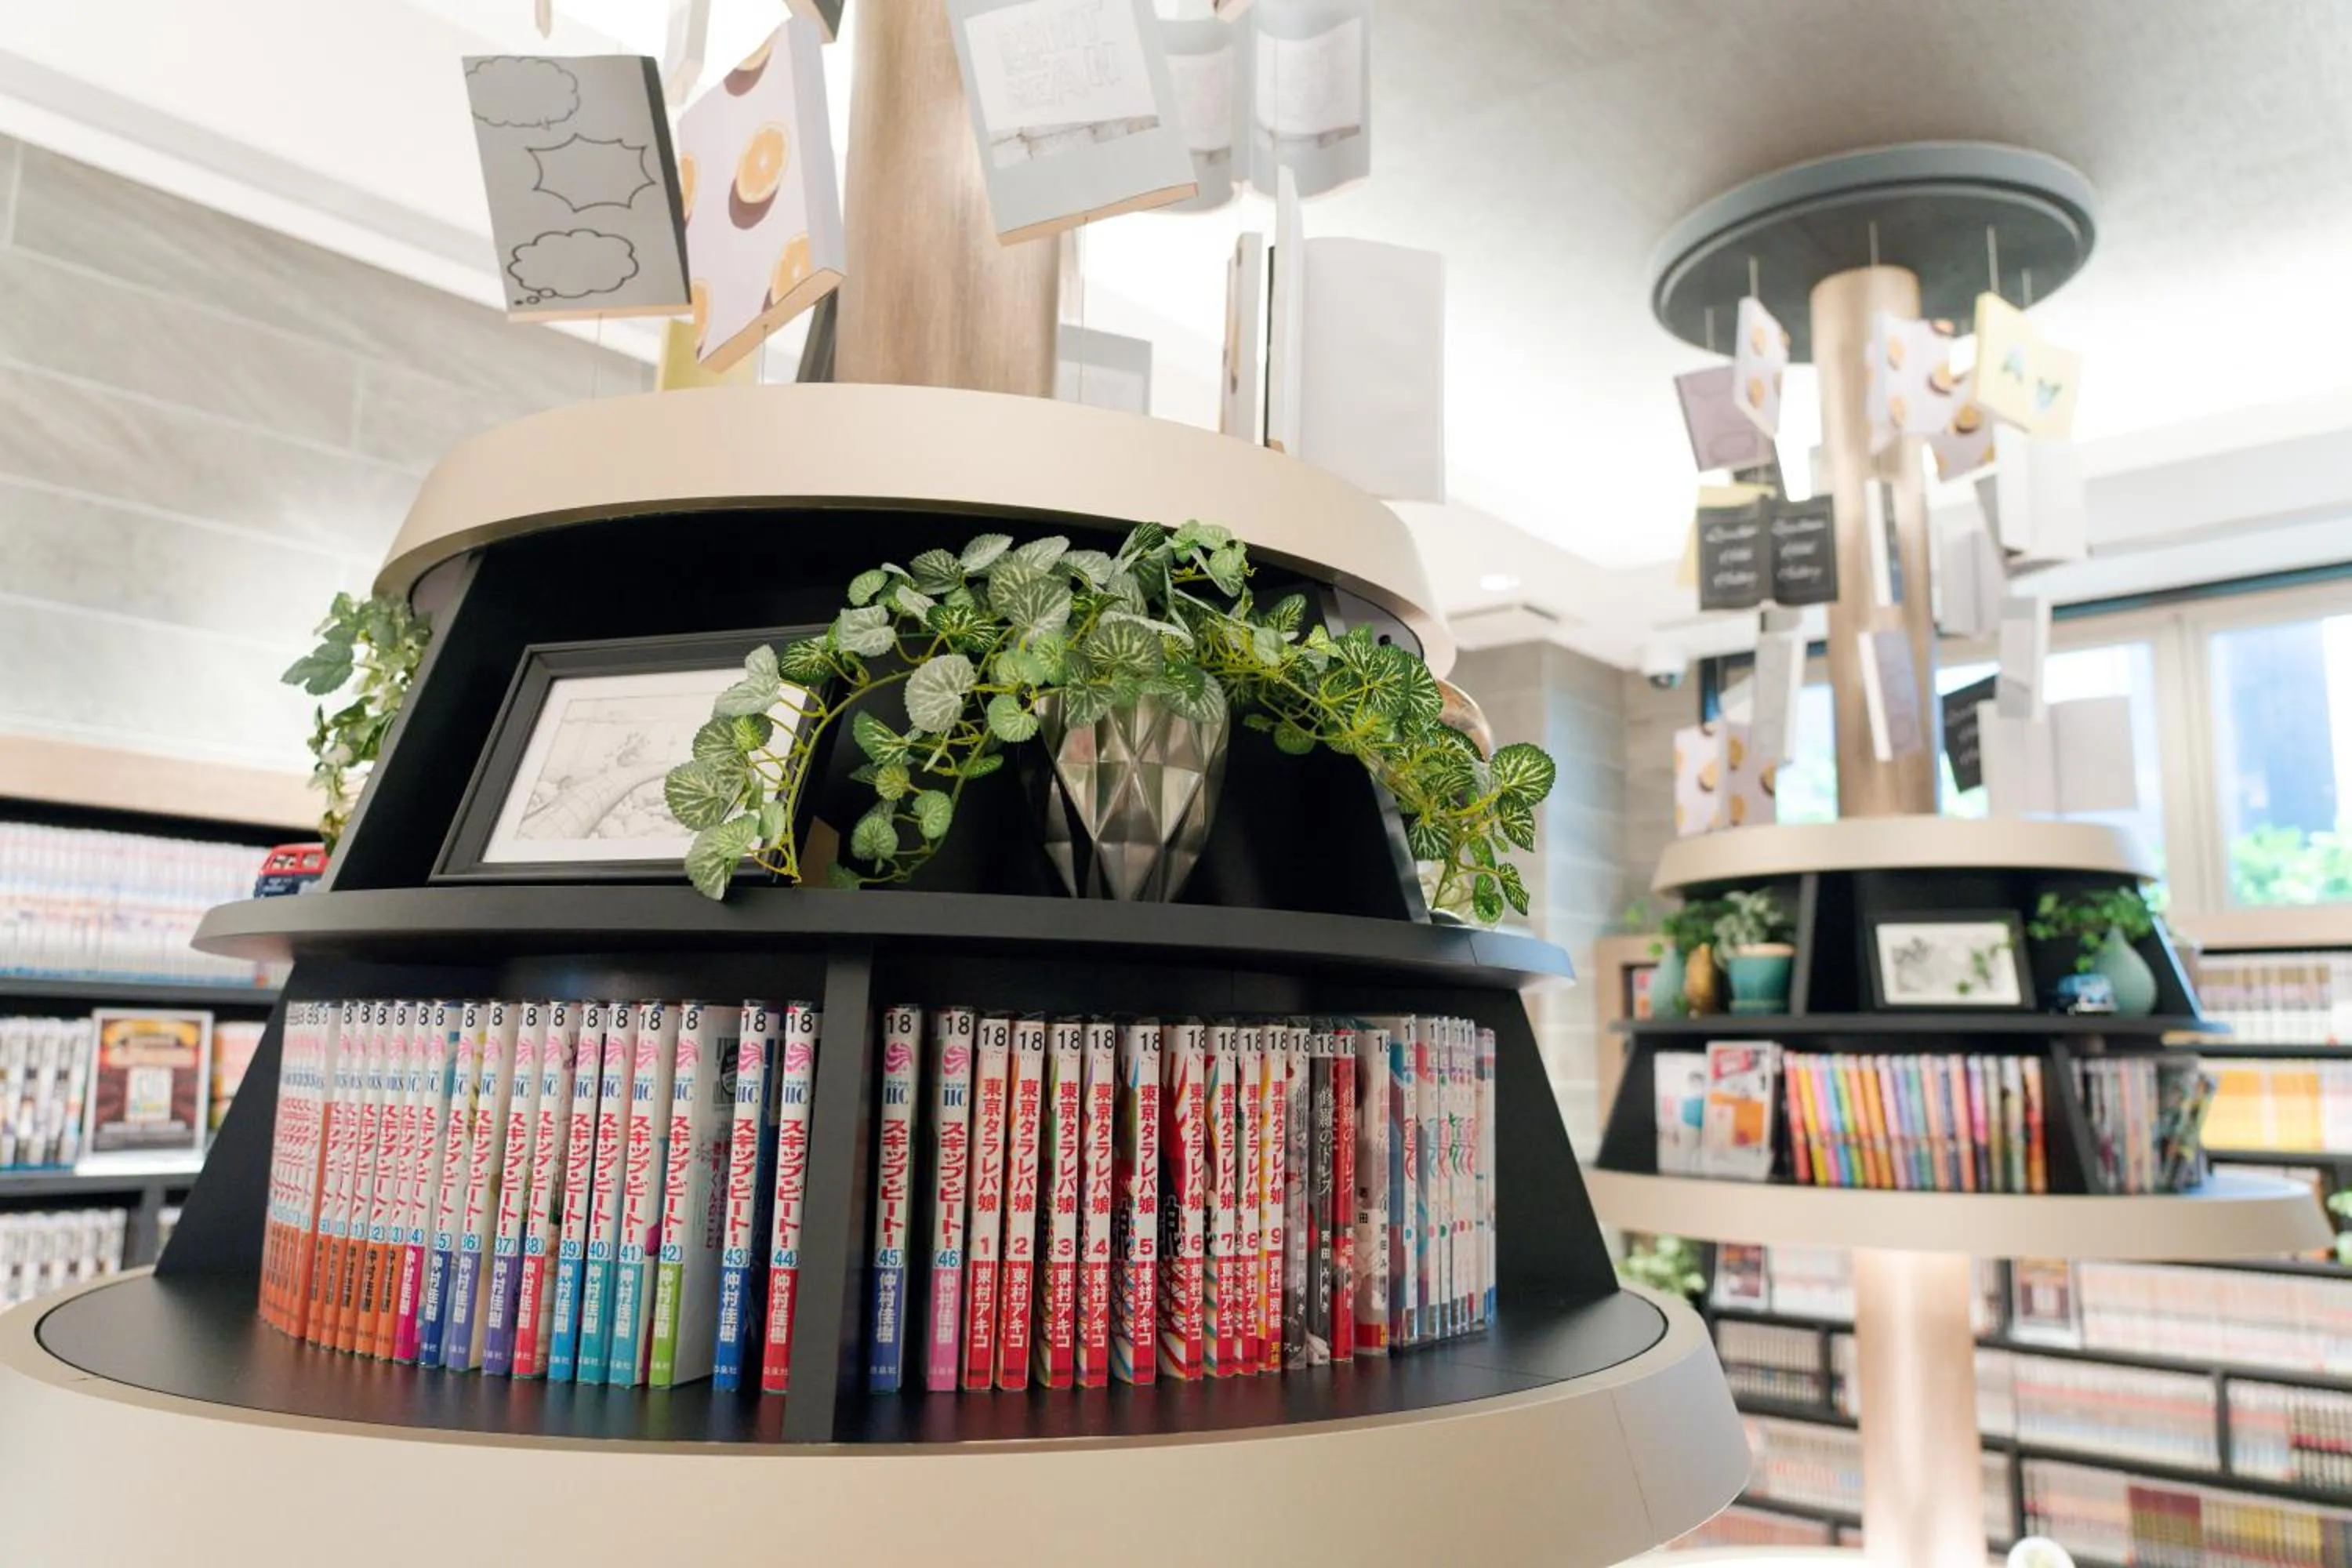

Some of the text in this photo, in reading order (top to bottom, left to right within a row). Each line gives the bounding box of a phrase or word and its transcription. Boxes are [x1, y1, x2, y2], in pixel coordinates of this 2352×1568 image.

[640, 1011, 661, 1031] 18
[679, 1011, 699, 1030] 18
[743, 1012, 766, 1033] 18
[789, 1013, 813, 1033] 18
[887, 1014, 911, 1034] 18
[946, 1015, 970, 1035] 18
[982, 1026, 1007, 1047] 18
[1020, 1031, 1043, 1051] 18
[1058, 1029, 1080, 1050] 18
[1091, 1029, 1114, 1050] 18
[1141, 1033, 1160, 1052] 18
[1269, 1031, 1287, 1051] 18
[1293, 1033, 1310, 1052] 18
[1318, 1036, 1334, 1054] 18
[978, 1078, 1004, 1212] 東京タラレバ娘
[1014, 1078, 1040, 1213] 東京タラレバ娘
[1056, 1080, 1078, 1214] 東京タラレバ娘
[1091, 1082, 1112, 1214] 東京タラレバ娘
[1138, 1083, 1158, 1214] 東京タラレバ娘
[1189, 1082, 1205, 1211] 東京タラレバ娘
[1220, 1083, 1236, 1210] 東京タラレバ娘
[980, 1236, 989, 1254] 1
[1014, 1236, 1028, 1255] 2
[1190, 1234, 1203, 1251] 6
[1221, 1233, 1233, 1250] 7
[1247, 1232, 1258, 1249] 8
[1270, 1228, 1281, 1244] 9
[1058, 1238, 1073, 1255] 3
[1094, 1239, 1108, 1255] 4
[1139, 1239, 1153, 1255] 5
[974, 1267, 993, 1348] 東村アキコ
[1009, 1267, 1028, 1348] 東村アキコ
[1056, 1268, 1073, 1348] 東村アキコ
[1091, 1269, 1107, 1348] 東村アキコ
[1138, 1268, 1154, 1347] 東村アキコ
[1189, 1264, 1203, 1341] 東村アキコ
